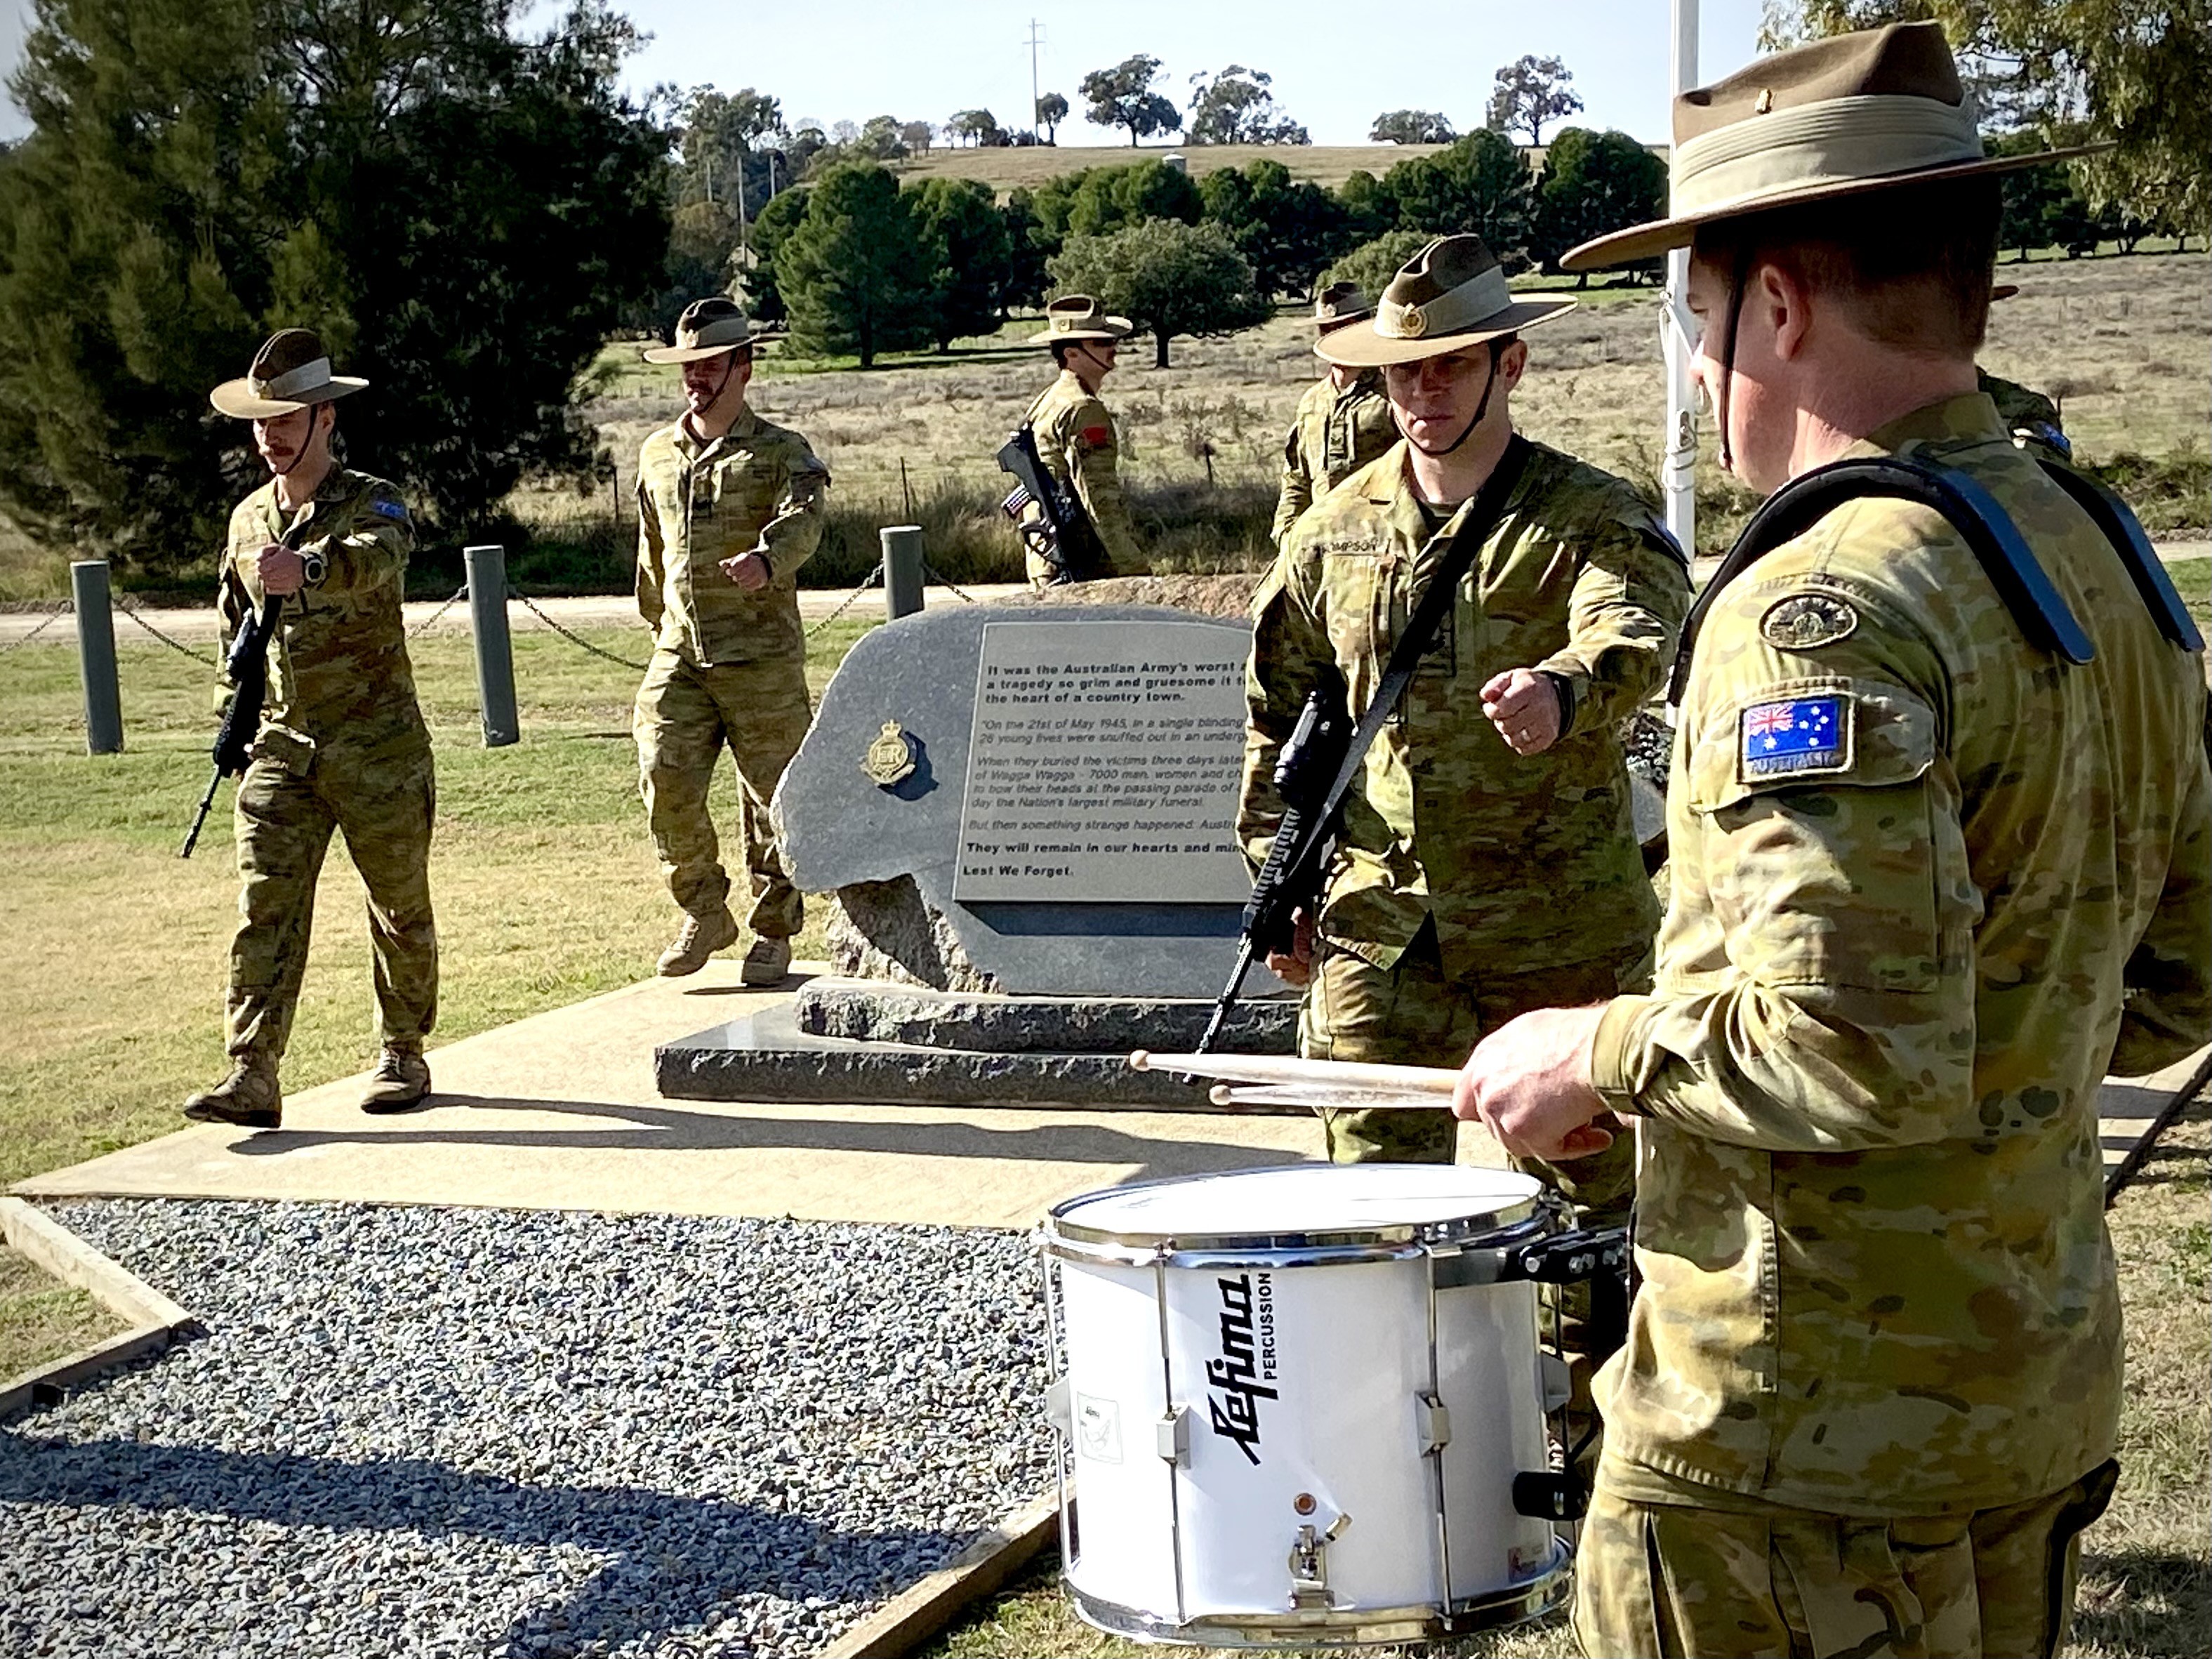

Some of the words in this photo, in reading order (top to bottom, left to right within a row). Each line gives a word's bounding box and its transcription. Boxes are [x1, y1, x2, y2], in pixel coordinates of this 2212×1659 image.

[988, 666, 998, 675] It
[1037, 666, 1058, 675] the
[1064, 663, 1134, 675] Australian
[1141, 662, 1188, 675] Army's
[1195, 661, 1235, 672] worst
[1000, 679, 1052, 691] tragedy
[1080, 678, 1110, 690] grim
[1115, 678, 1141, 687] and
[1146, 677, 1215, 689] gruesome
[1221, 675, 1231, 685] it
[986, 694, 1007, 703] the
[1013, 693, 1049, 702] heart
[1054, 692, 1069, 701] of
[1087, 692, 1141, 703] country
[1146, 692, 1185, 701] town.
[1006, 720, 1024, 729] the
[1027, 719, 1052, 729] 21st
[1055, 719, 1068, 729] of
[1071, 719, 1094, 730] May
[1148, 720, 1155, 728] a
[1160, 718, 1194, 729] single
[1198, 717, 1243, 728] blinding
[980, 734, 995, 743] 26
[999, 735, 1033, 746] young
[1036, 733, 1063, 743] lives
[1099, 732, 1144, 742] snuffed
[1147, 732, 1167, 742] out
[1172, 732, 1181, 741] in
[1203, 731, 1248, 743] underg
[978, 756, 1010, 766] When
[1014, 756, 1039, 768] they
[1042, 755, 1080, 766] buried
[1084, 755, 1101, 765] the
[1106, 756, 1147, 765] victims
[1151, 755, 1182, 765] three
[1186, 755, 1214, 767] days
[975, 772, 988, 781] of
[991, 772, 1031, 782] Wagga
[1035, 771, 1075, 782] Wagga
[1089, 769, 1118, 779] 7000
[1155, 771, 1198, 779] women
[1201, 769, 1224, 779] and
[974, 784, 985, 793] to
[988, 784, 1013, 793] bow
[1016, 784, 1042, 793] their
[1046, 784, 1082, 793] heads
[1086, 784, 1097, 793] at
[1101, 784, 1120, 793] the
[1124, 784, 1171, 795] passing
[1174, 782, 1217, 794] parade
[1220, 782, 1234, 793] of
[972, 798, 991, 810] day
[996, 798, 1015, 807] the
[1019, 798, 1064, 807] Nation's
[1068, 797, 1109, 809] largest
[1112, 796, 1156, 808] military
[969, 820, 989, 830] But
[992, 819, 1018, 830] then
[1021, 819, 1081, 832] something
[1085, 820, 1130, 831] strange
[1199, 819, 1236, 830] Austr
[967, 842, 1000, 855] They
[1005, 843, 1029, 852] will
[1034, 843, 1082, 852] remain
[1086, 843, 1099, 852] in
[1104, 844, 1127, 852] our
[1132, 842, 1178, 852] hearts
[1184, 843, 1210, 852] and
[1215, 843, 1241, 852] min
[963, 866, 993, 875] Lest
[1000, 866, 1019, 876] We
[1258, 1273, 1278, 1380] PERCUSSION
